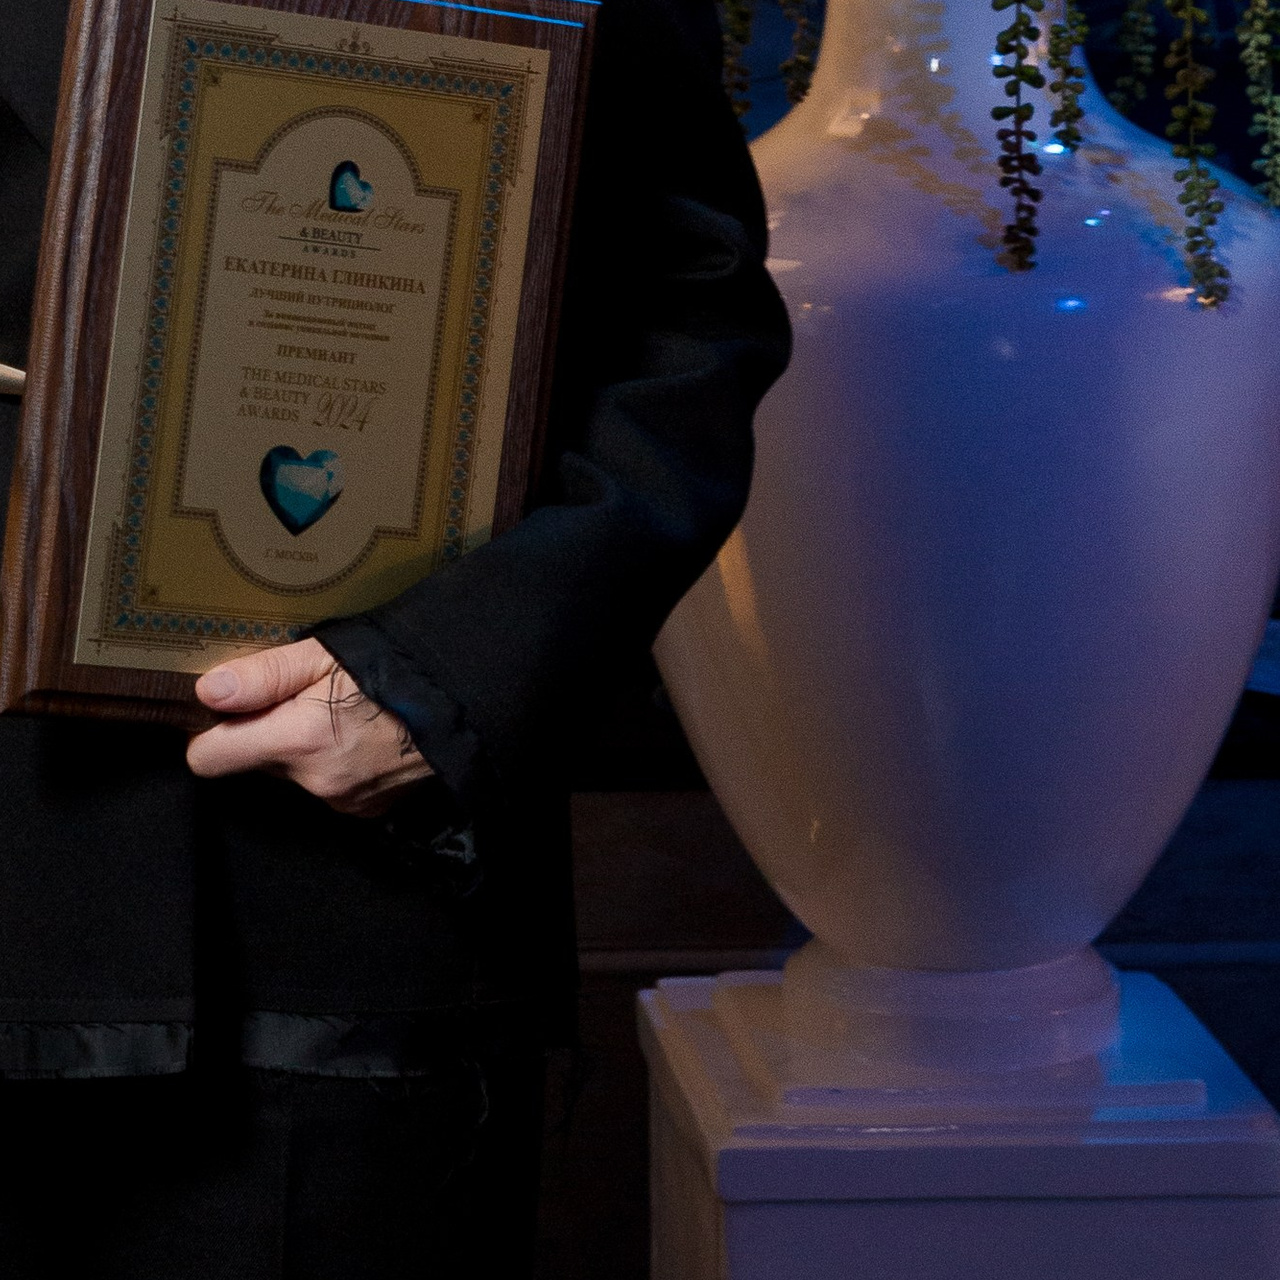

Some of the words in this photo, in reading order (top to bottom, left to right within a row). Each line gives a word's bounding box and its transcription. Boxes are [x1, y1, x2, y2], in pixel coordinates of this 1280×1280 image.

[241, 189, 285, 214] The
[374, 206, 426, 234] Stars
[300, 227, 308, 238] &
[312, 227, 363, 245] BEAUTY
[302, 245, 357, 259] AWARDS
[224, 256, 327, 283] ЕКАТЕРИНА
[332, 269, 426, 295] ГЛИНКИНА
[276, 344, 358, 365] ПРЕМИАНТ
[241, 366, 271, 381] THE
[274, 370, 341, 390] MEDICAL
[342, 378, 387, 394] STARS
[239, 386, 249, 398] &
[253, 387, 311, 405] BEAUTY
[237, 403, 300, 422] AWARDS
[312, 391, 380, 432] 2024
